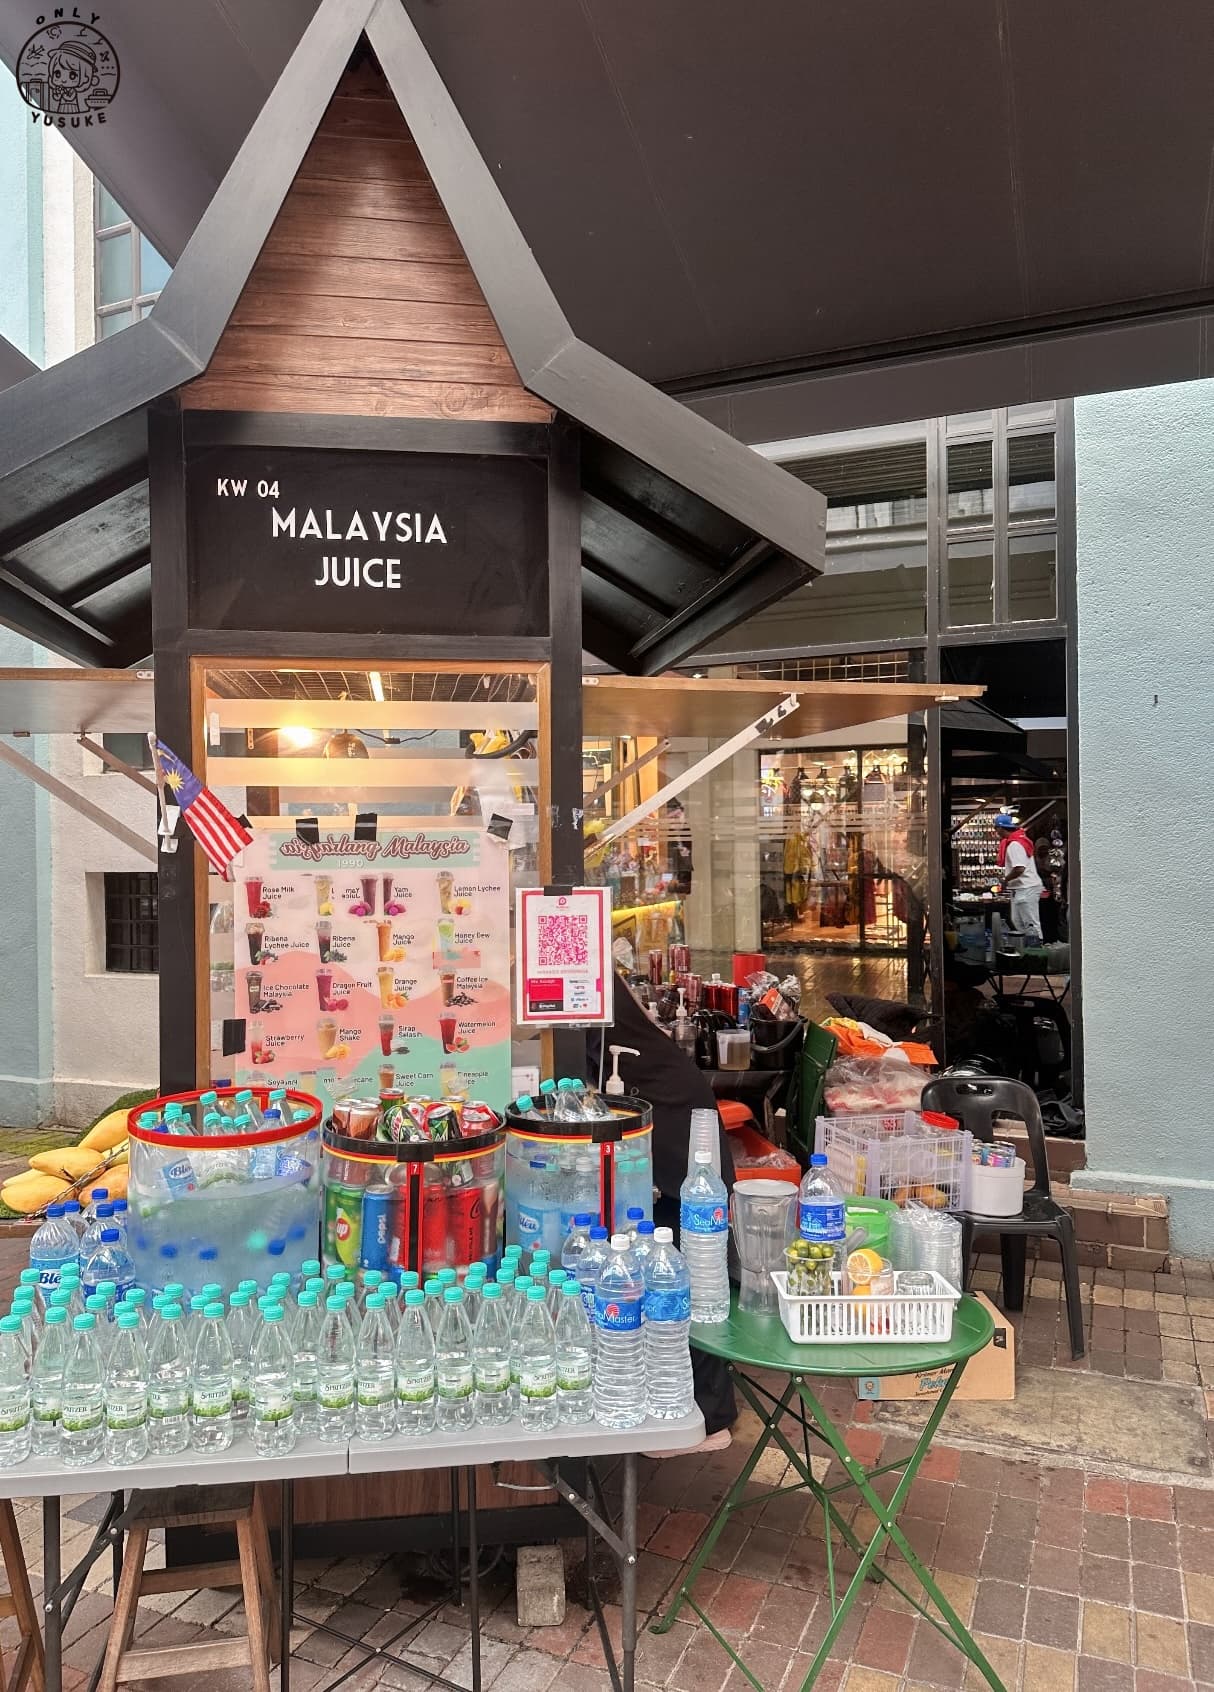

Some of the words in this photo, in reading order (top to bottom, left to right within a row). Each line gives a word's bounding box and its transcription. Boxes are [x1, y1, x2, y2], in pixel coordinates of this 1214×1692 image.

[217, 478, 248, 497] KW
[257, 480, 280, 499] 04
[272, 506, 448, 544] MALAYSIA
[315, 556, 402, 589] JUICE
[382, 833, 471, 861] Malaysia
[477, 884, 501, 893] Lychee
[394, 978, 418, 987] Orange
[456, 976, 478, 984] Coffee
[332, 981, 356, 990] Dragon
[339, 1028, 362, 1037] Mango
